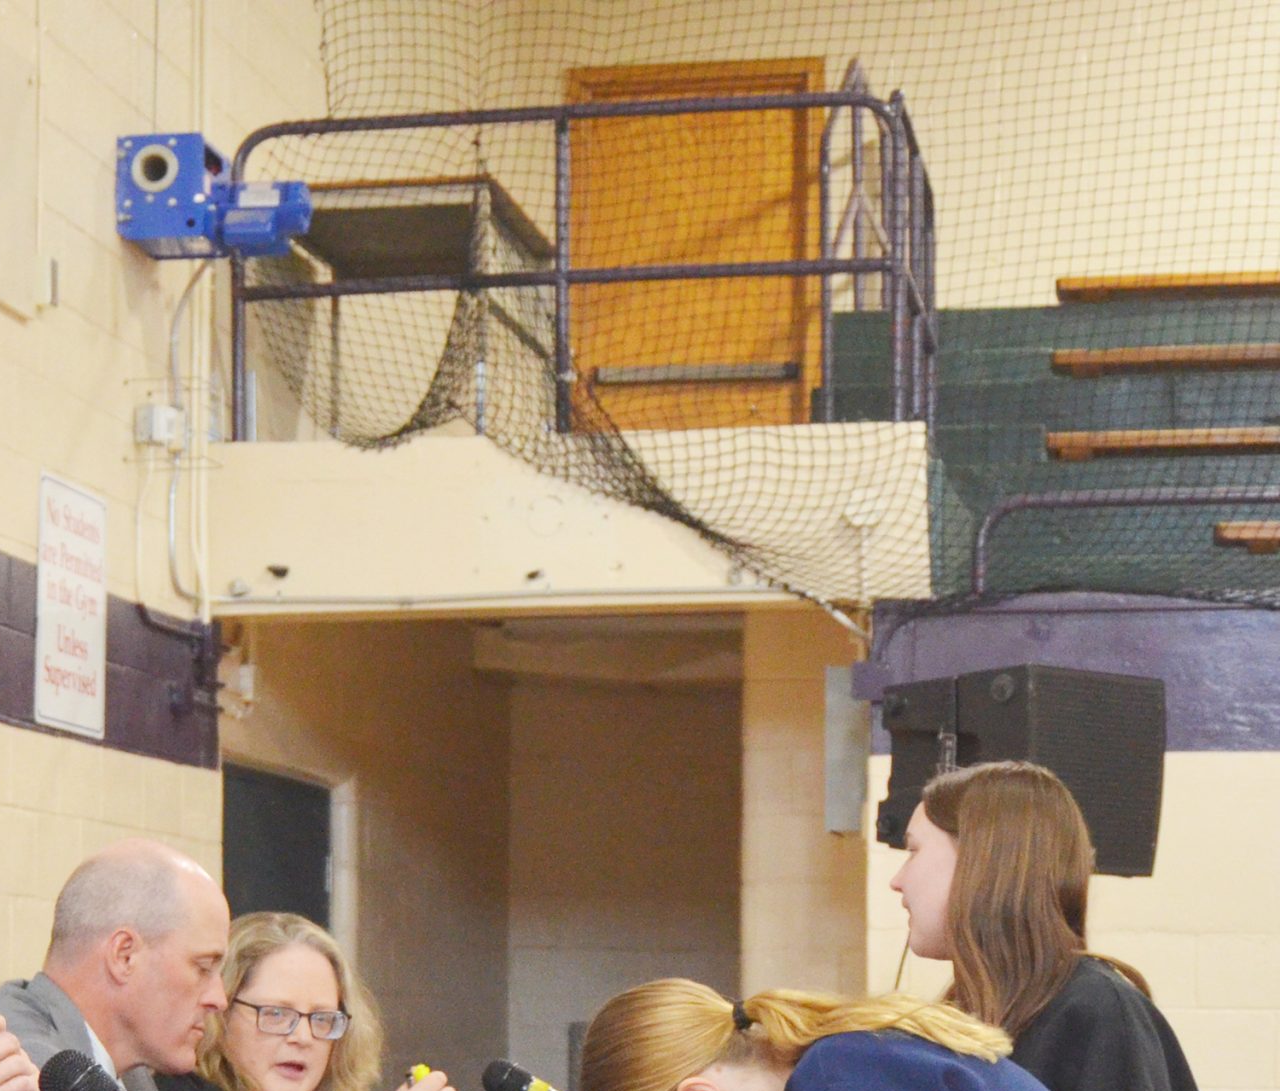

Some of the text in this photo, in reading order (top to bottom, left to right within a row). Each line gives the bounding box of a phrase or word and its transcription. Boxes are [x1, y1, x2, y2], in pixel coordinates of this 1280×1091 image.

[46, 496, 100, 545] No Students
[41, 542, 102, 584] are Permitted
[46, 571, 97, 621] in the Gym
[57, 623, 88, 662] Unless
[43, 653, 97, 697] Supervised
